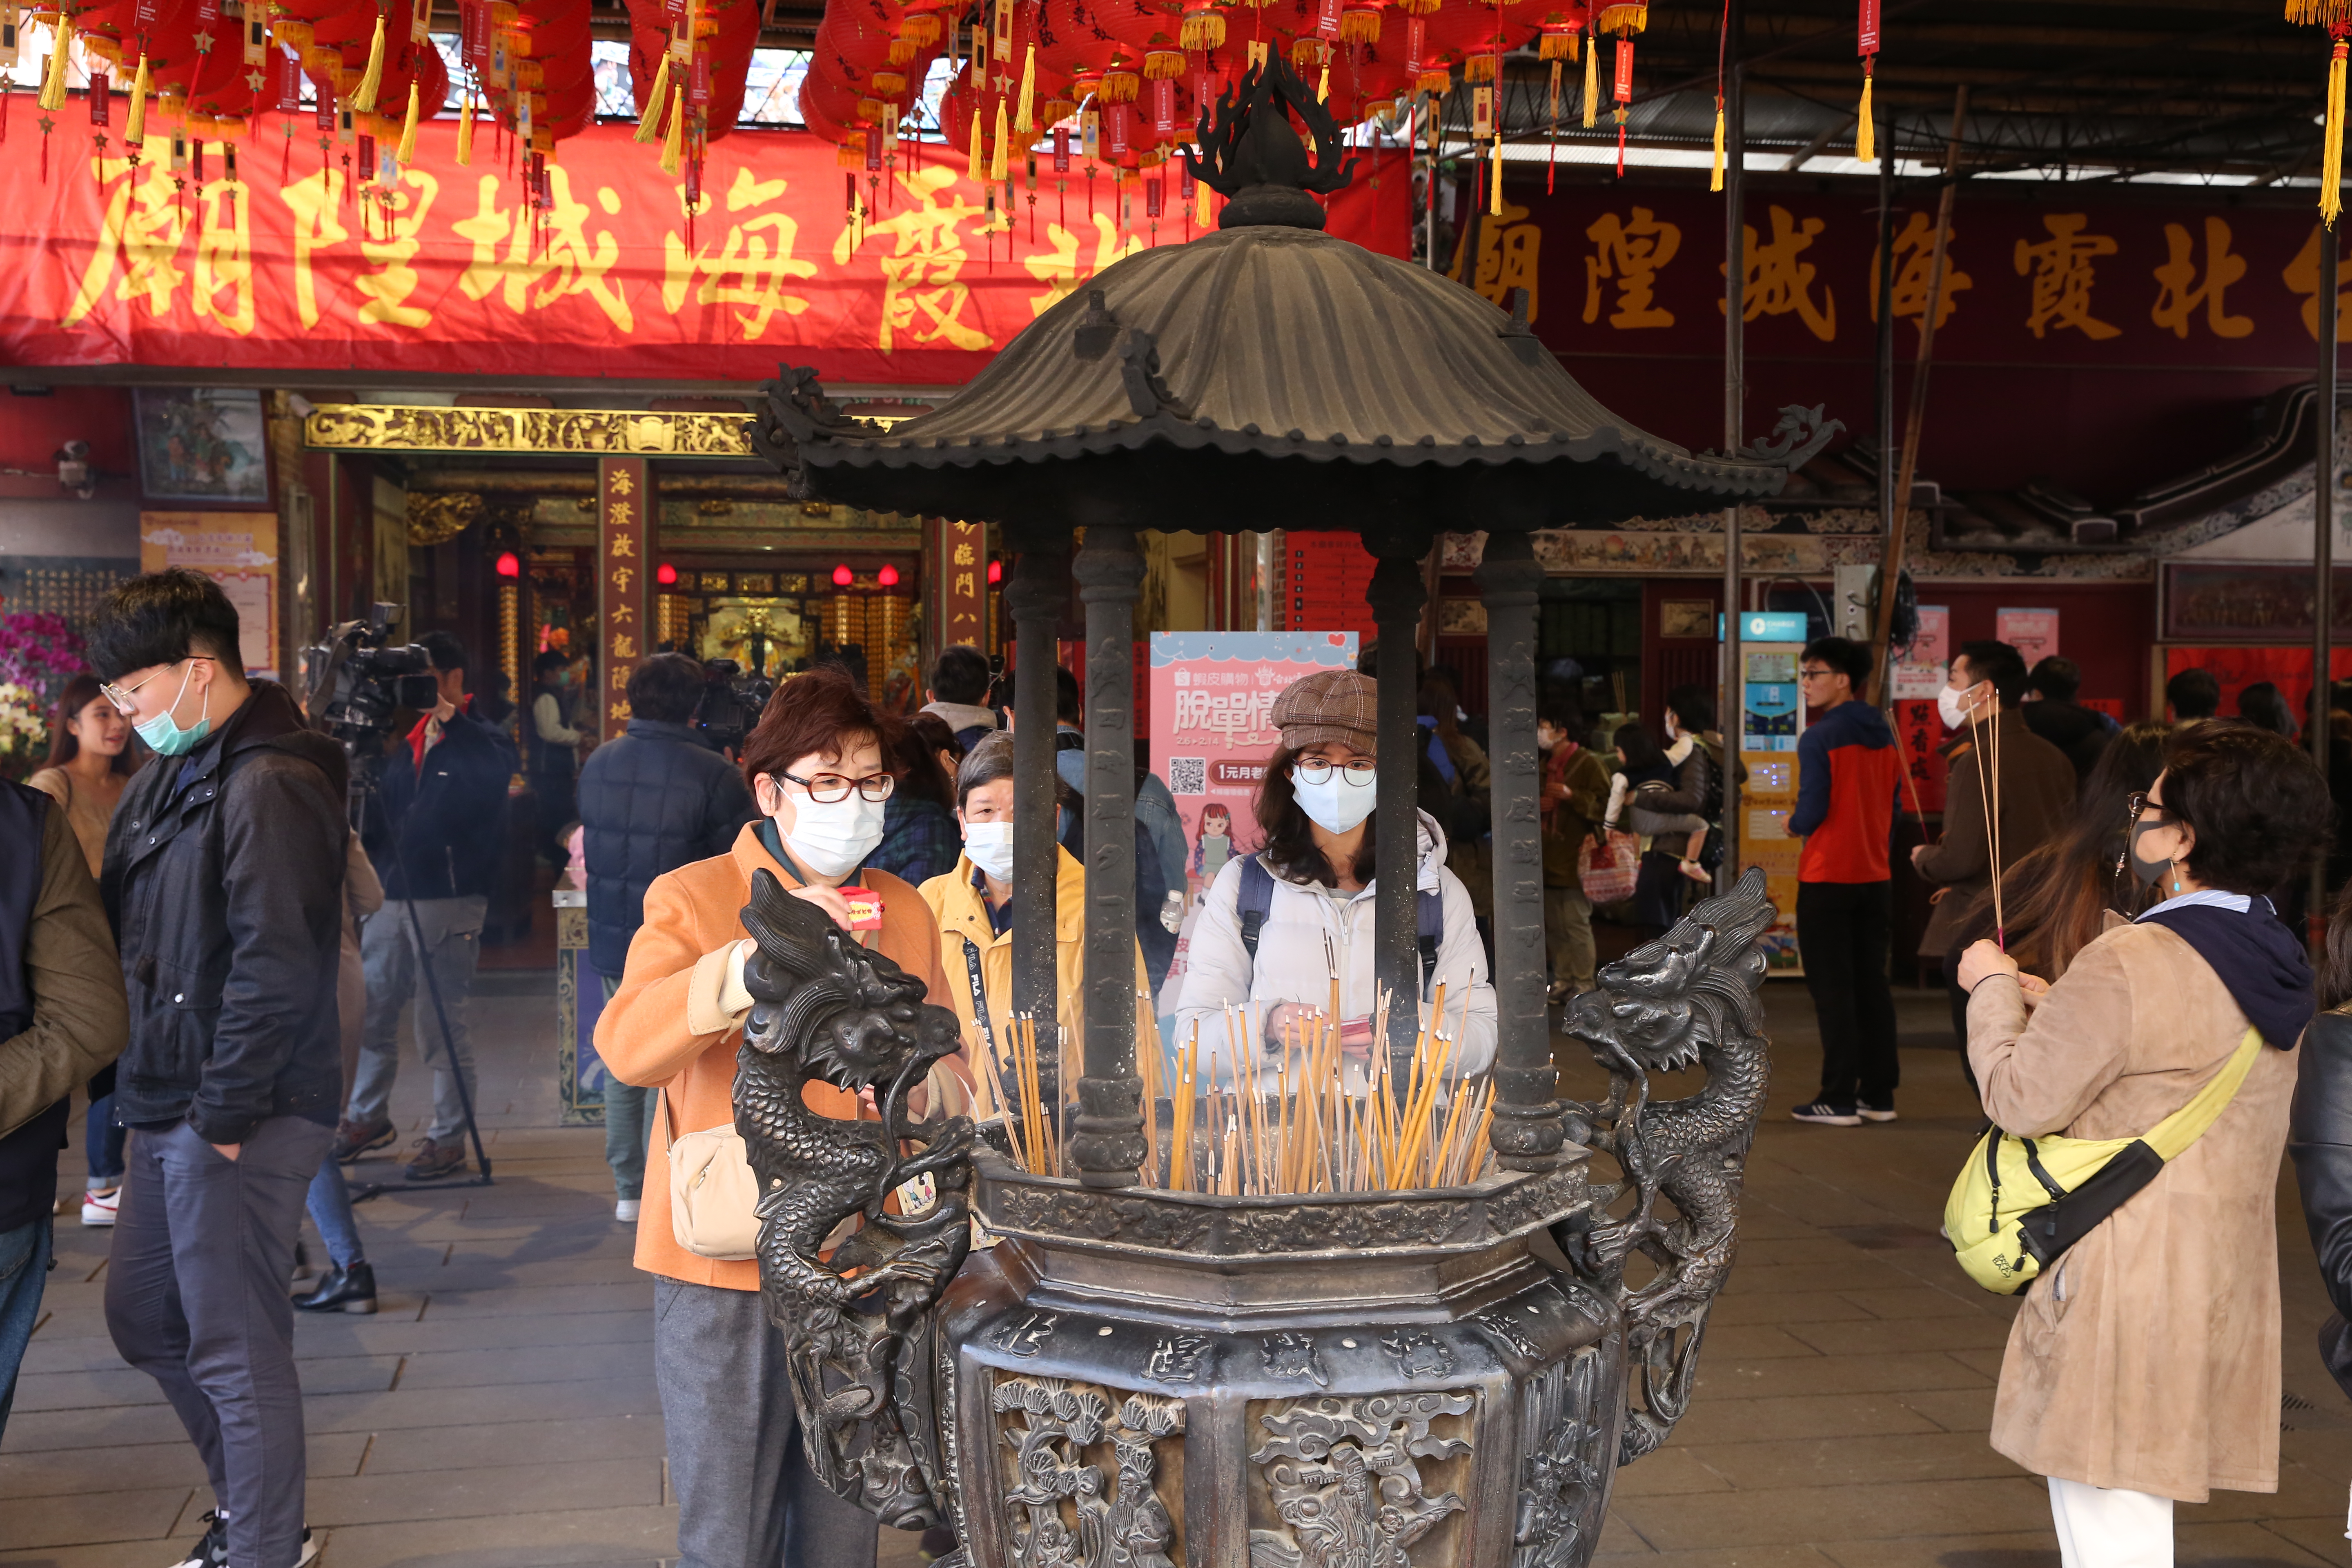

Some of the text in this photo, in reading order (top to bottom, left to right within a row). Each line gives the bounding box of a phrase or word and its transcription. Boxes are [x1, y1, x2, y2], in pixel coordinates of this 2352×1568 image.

[1193, 672, 1248, 686] 蝦皮購物
[1219, 764, 1267, 780] 1元月老
[971, 973, 981, 996] FILA
[976, 1000, 987, 1023] FILA
